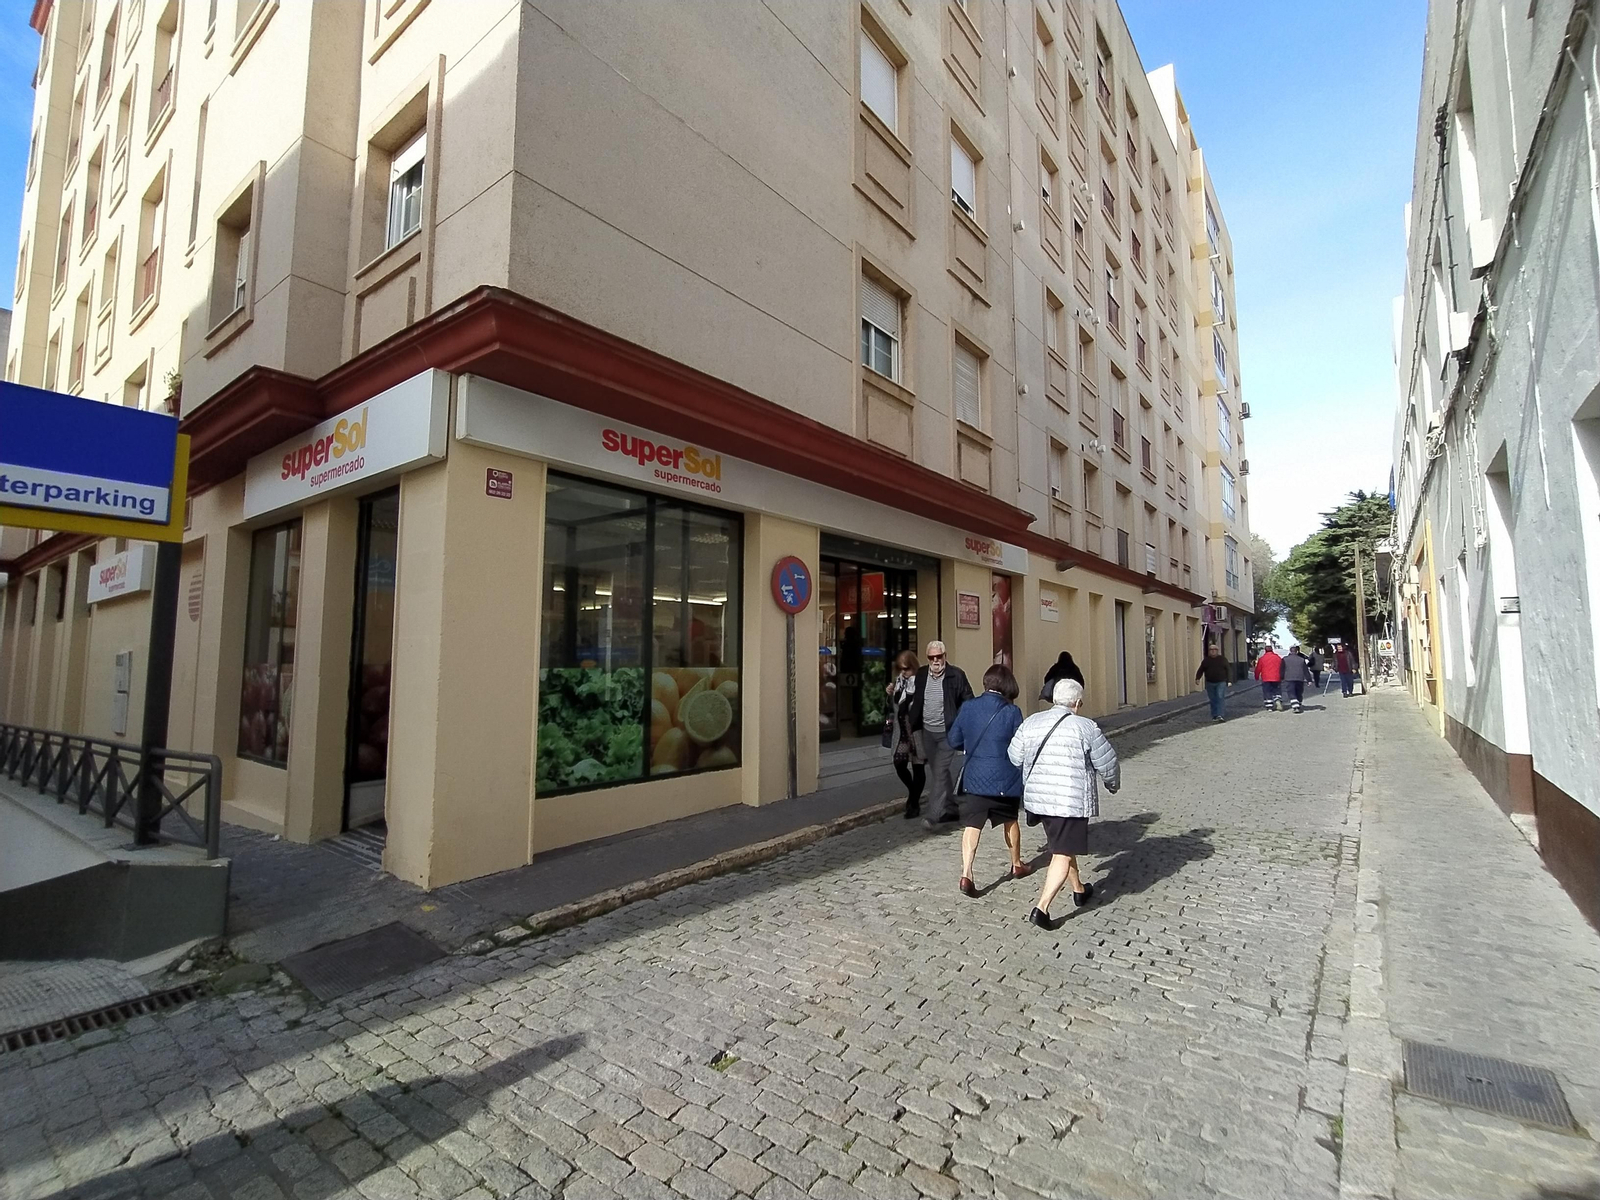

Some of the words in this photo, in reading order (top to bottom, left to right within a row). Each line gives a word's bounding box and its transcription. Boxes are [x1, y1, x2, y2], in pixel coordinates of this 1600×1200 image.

[281, 406, 368, 481] superSol
[602, 428, 722, 482] superSol
[310, 455, 365, 488] supermercado
[654, 468, 722, 494] supermercado
[0, 474, 156, 516] terparking
[965, 537, 1003, 558] superSol
